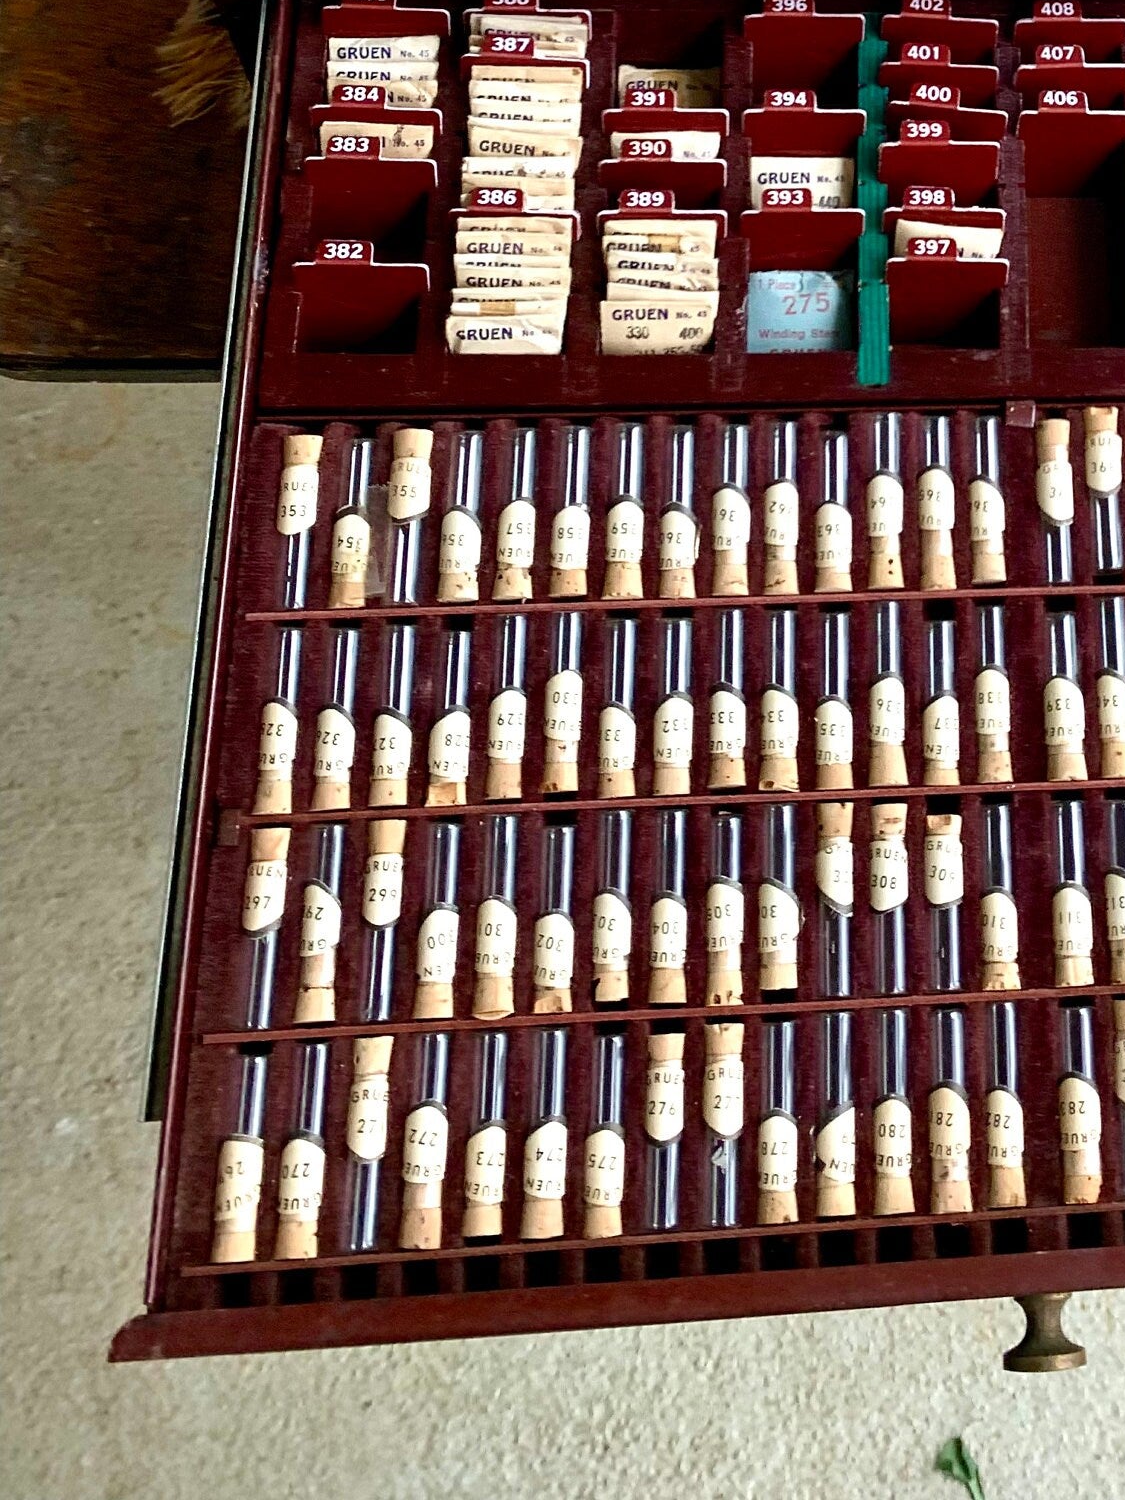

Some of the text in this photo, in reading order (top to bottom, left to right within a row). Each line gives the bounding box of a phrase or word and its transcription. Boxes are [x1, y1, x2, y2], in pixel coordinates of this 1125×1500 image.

[1040, 2, 1075, 16] 408
[491, 37, 531, 52] 387
[337, 47, 391, 59] GRUEN
[907, 46, 940, 60] 401
[1040, 46, 1075, 60] 407
[340, 86, 379, 101] 384
[630, 91, 666, 106] 391
[770, 92, 807, 107] 394
[915, 86, 952, 101] 400
[1043, 91, 1078, 106] 406
[907, 123, 943, 138] 399
[330, 137, 370, 152] 383
[479, 140, 535, 155] GRUEN
[628, 140, 667, 156] 390
[757, 172, 811, 184] GRUEN
[477, 189, 517, 205] 386
[625, 191, 665, 207] 389
[766, 190, 804, 205] 393
[909, 190, 946, 205] 398
[323, 243, 363, 259] 382
[466, 243, 524, 255] GRUEN
[914, 240, 951, 255] 397
[465, 276, 523, 287] GRUEN
[782, 292, 830, 315] 275
[612, 308, 669, 320] GRUEN
[456, 327, 513, 340] GRUEN
[759, 328, 805, 340] Winding
[280, 503, 308, 517] 353
